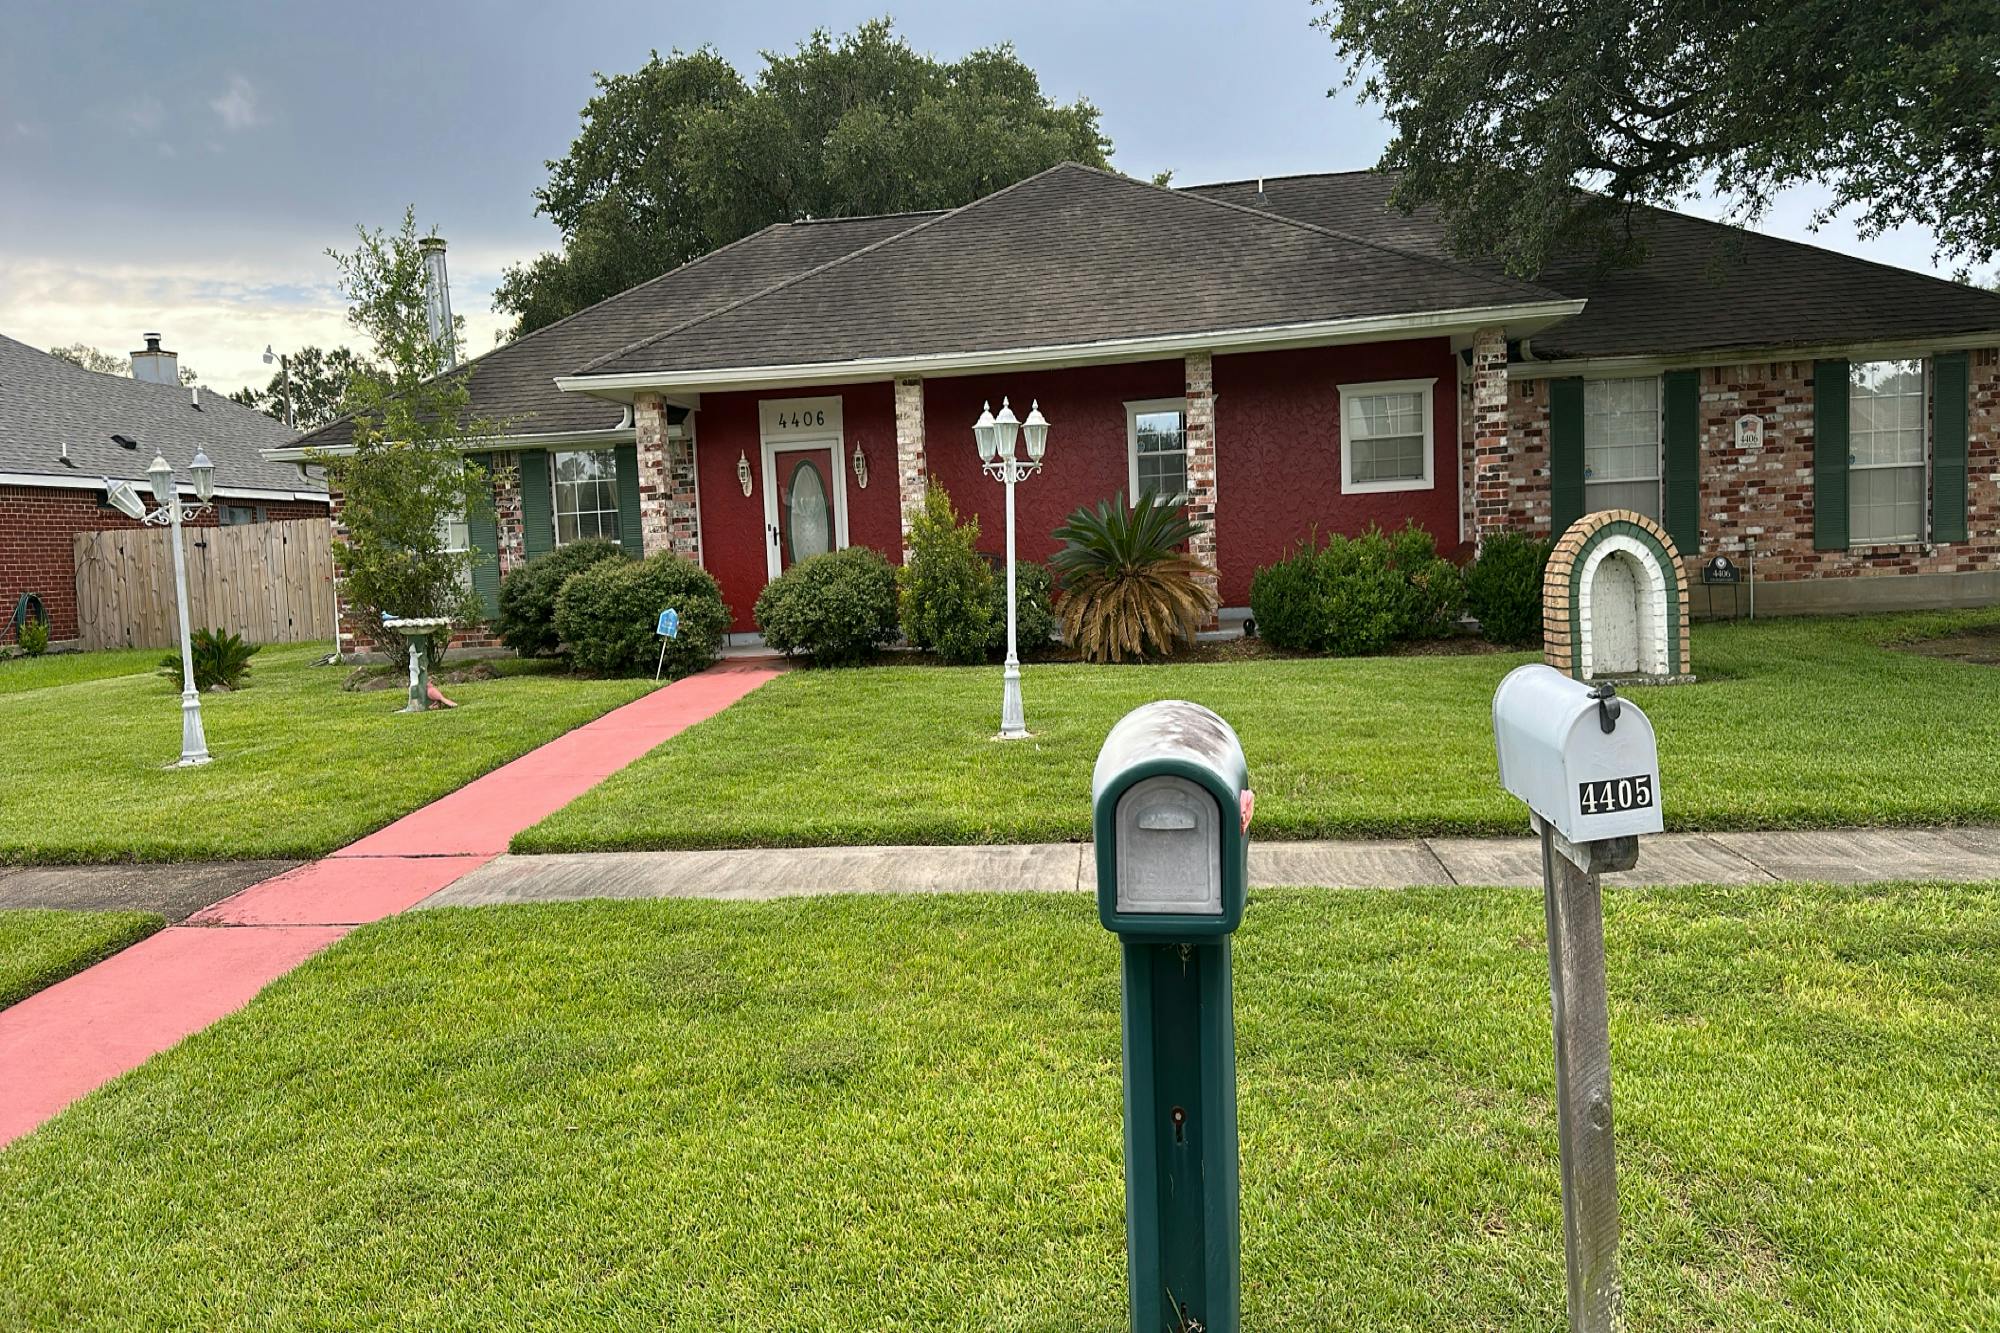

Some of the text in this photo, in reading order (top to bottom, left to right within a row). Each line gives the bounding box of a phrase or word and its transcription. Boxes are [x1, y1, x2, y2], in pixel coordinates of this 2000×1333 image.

[779, 410, 824, 428] 4406
[1740, 434, 1759, 443] 4406
[1713, 570, 1731, 578] 4406
[1581, 777, 1650, 813] 4405
